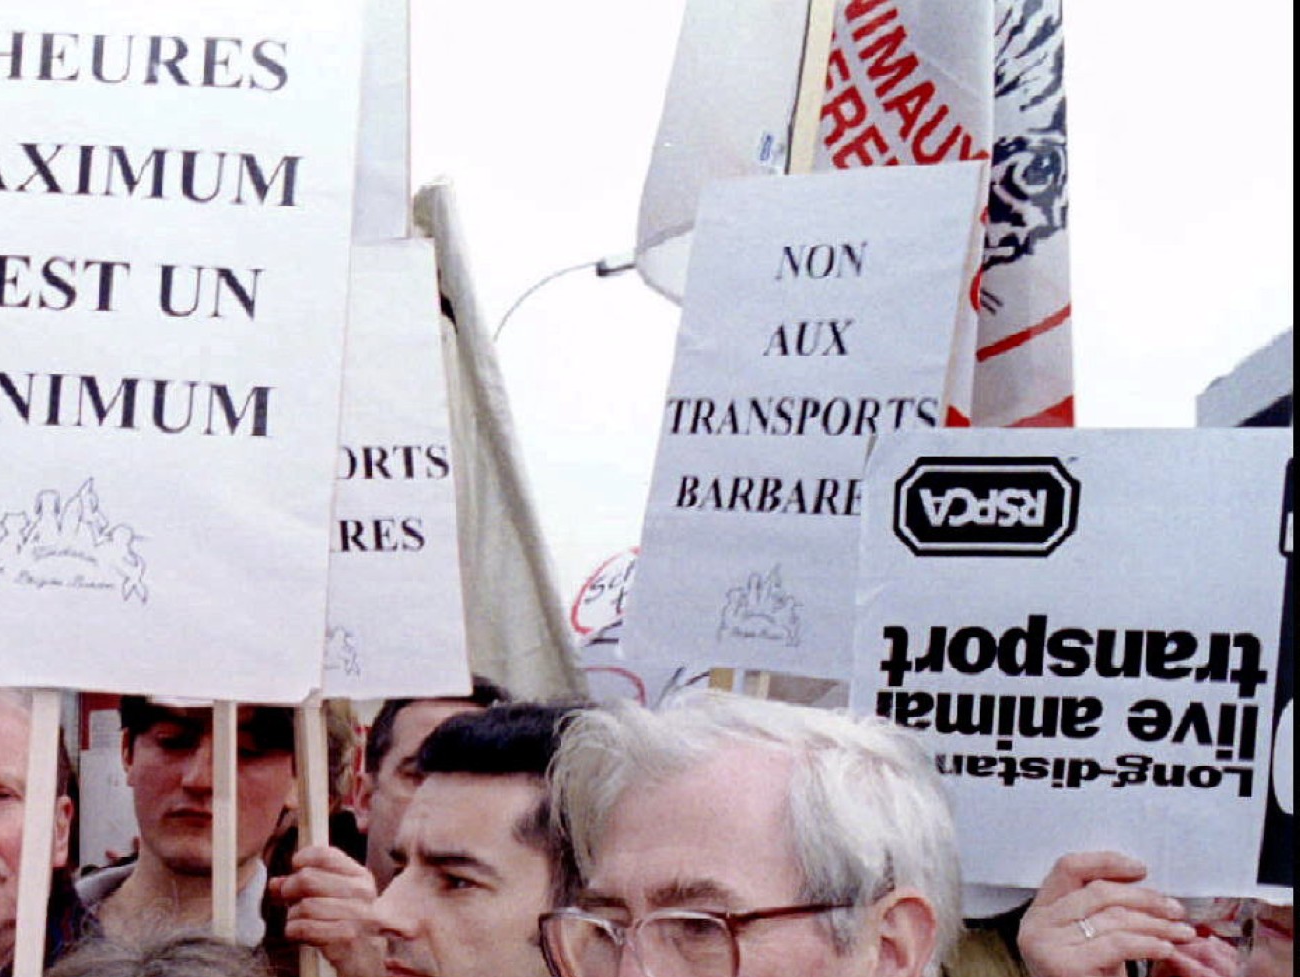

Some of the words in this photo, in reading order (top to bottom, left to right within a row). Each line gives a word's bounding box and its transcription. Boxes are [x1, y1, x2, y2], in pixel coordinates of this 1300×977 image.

[775, 241, 868, 280] NON
[160, 264, 262, 318] UN
[762, 319, 853, 357] AUX
[664, 392, 940, 438] TRANSPORTS
[918, 487, 1049, 528] RSPCA
[334, 517, 427, 554] RES
[879, 614, 1269, 700] transport
[1127, 700, 1261, 763] live
